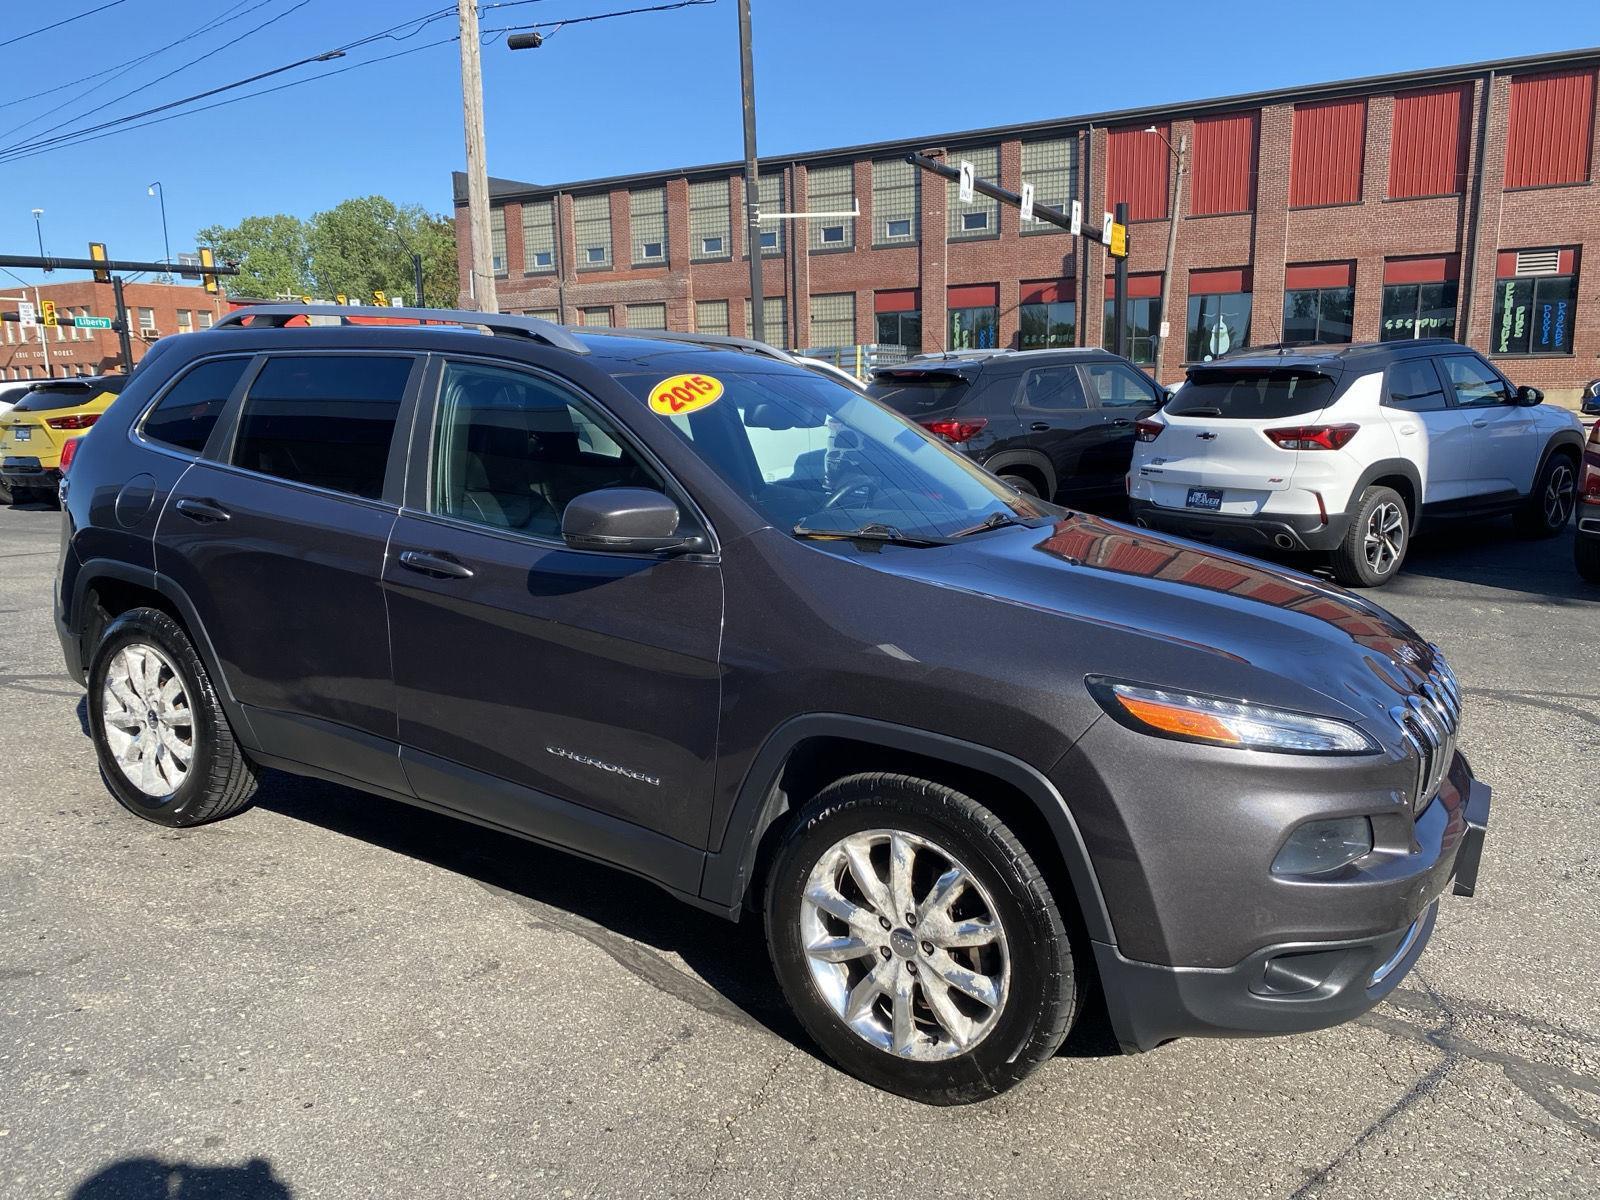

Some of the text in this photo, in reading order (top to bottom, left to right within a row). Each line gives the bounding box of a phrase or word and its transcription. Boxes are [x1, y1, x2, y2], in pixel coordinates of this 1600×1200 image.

[78, 318, 107, 328] Liberty
[1514, 306, 1525, 338] PUPS
[53, 349, 74, 357] WORKS
[658, 376, 714, 412] 2015
[1188, 495, 1220, 506] WEAVER
[546, 746, 660, 786] CHEROKEE
